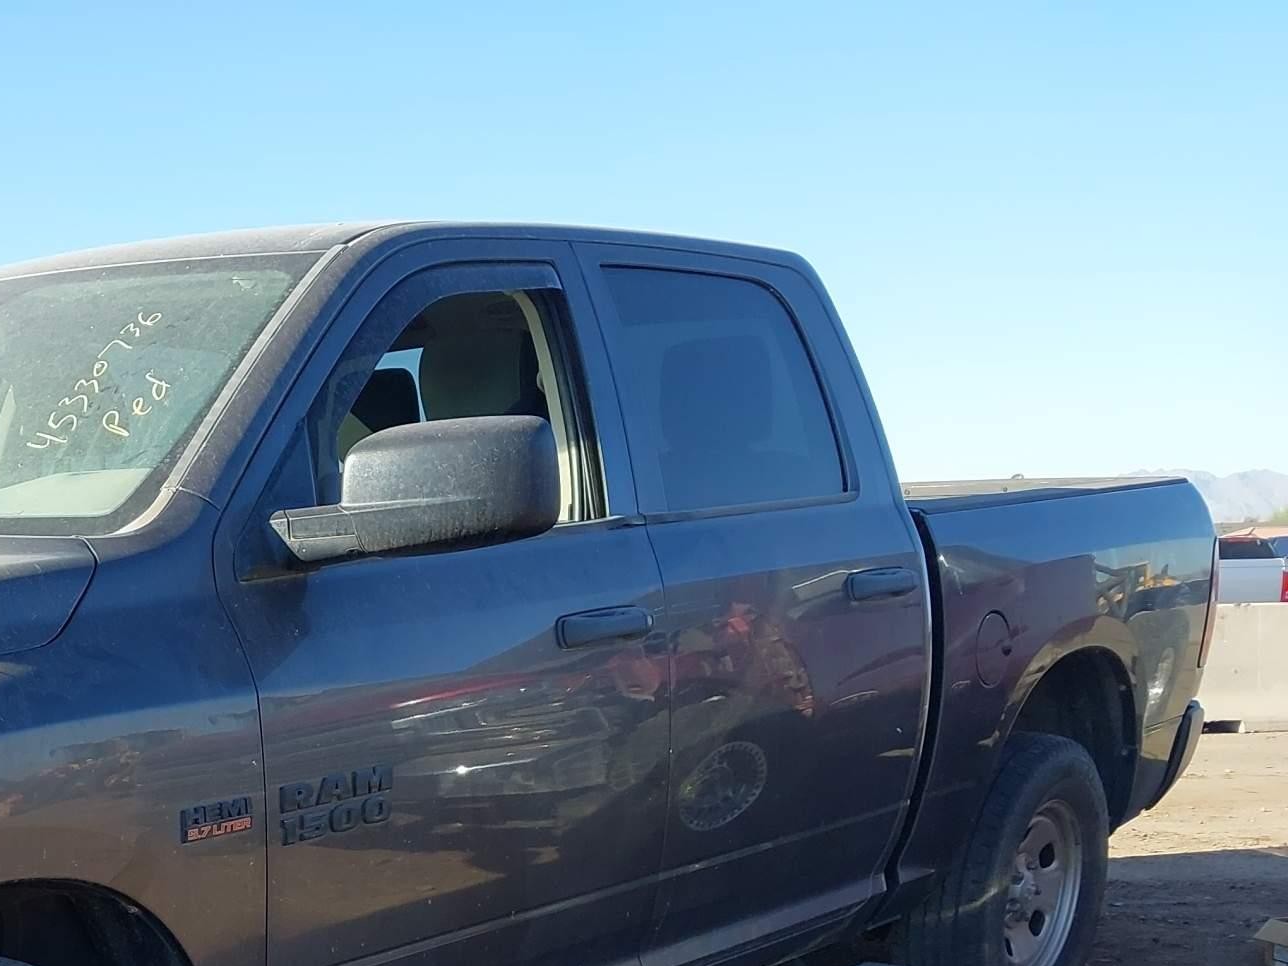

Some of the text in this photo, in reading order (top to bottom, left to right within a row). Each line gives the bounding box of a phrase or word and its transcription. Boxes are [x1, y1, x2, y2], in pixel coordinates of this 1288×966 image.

[25, 310, 162, 449] 45330736
[180, 796, 253, 829] HEMI
[279, 766, 393, 813] RAM
[187, 817, 252, 841] 5.7 LITER
[280, 796, 392, 846] 1500
